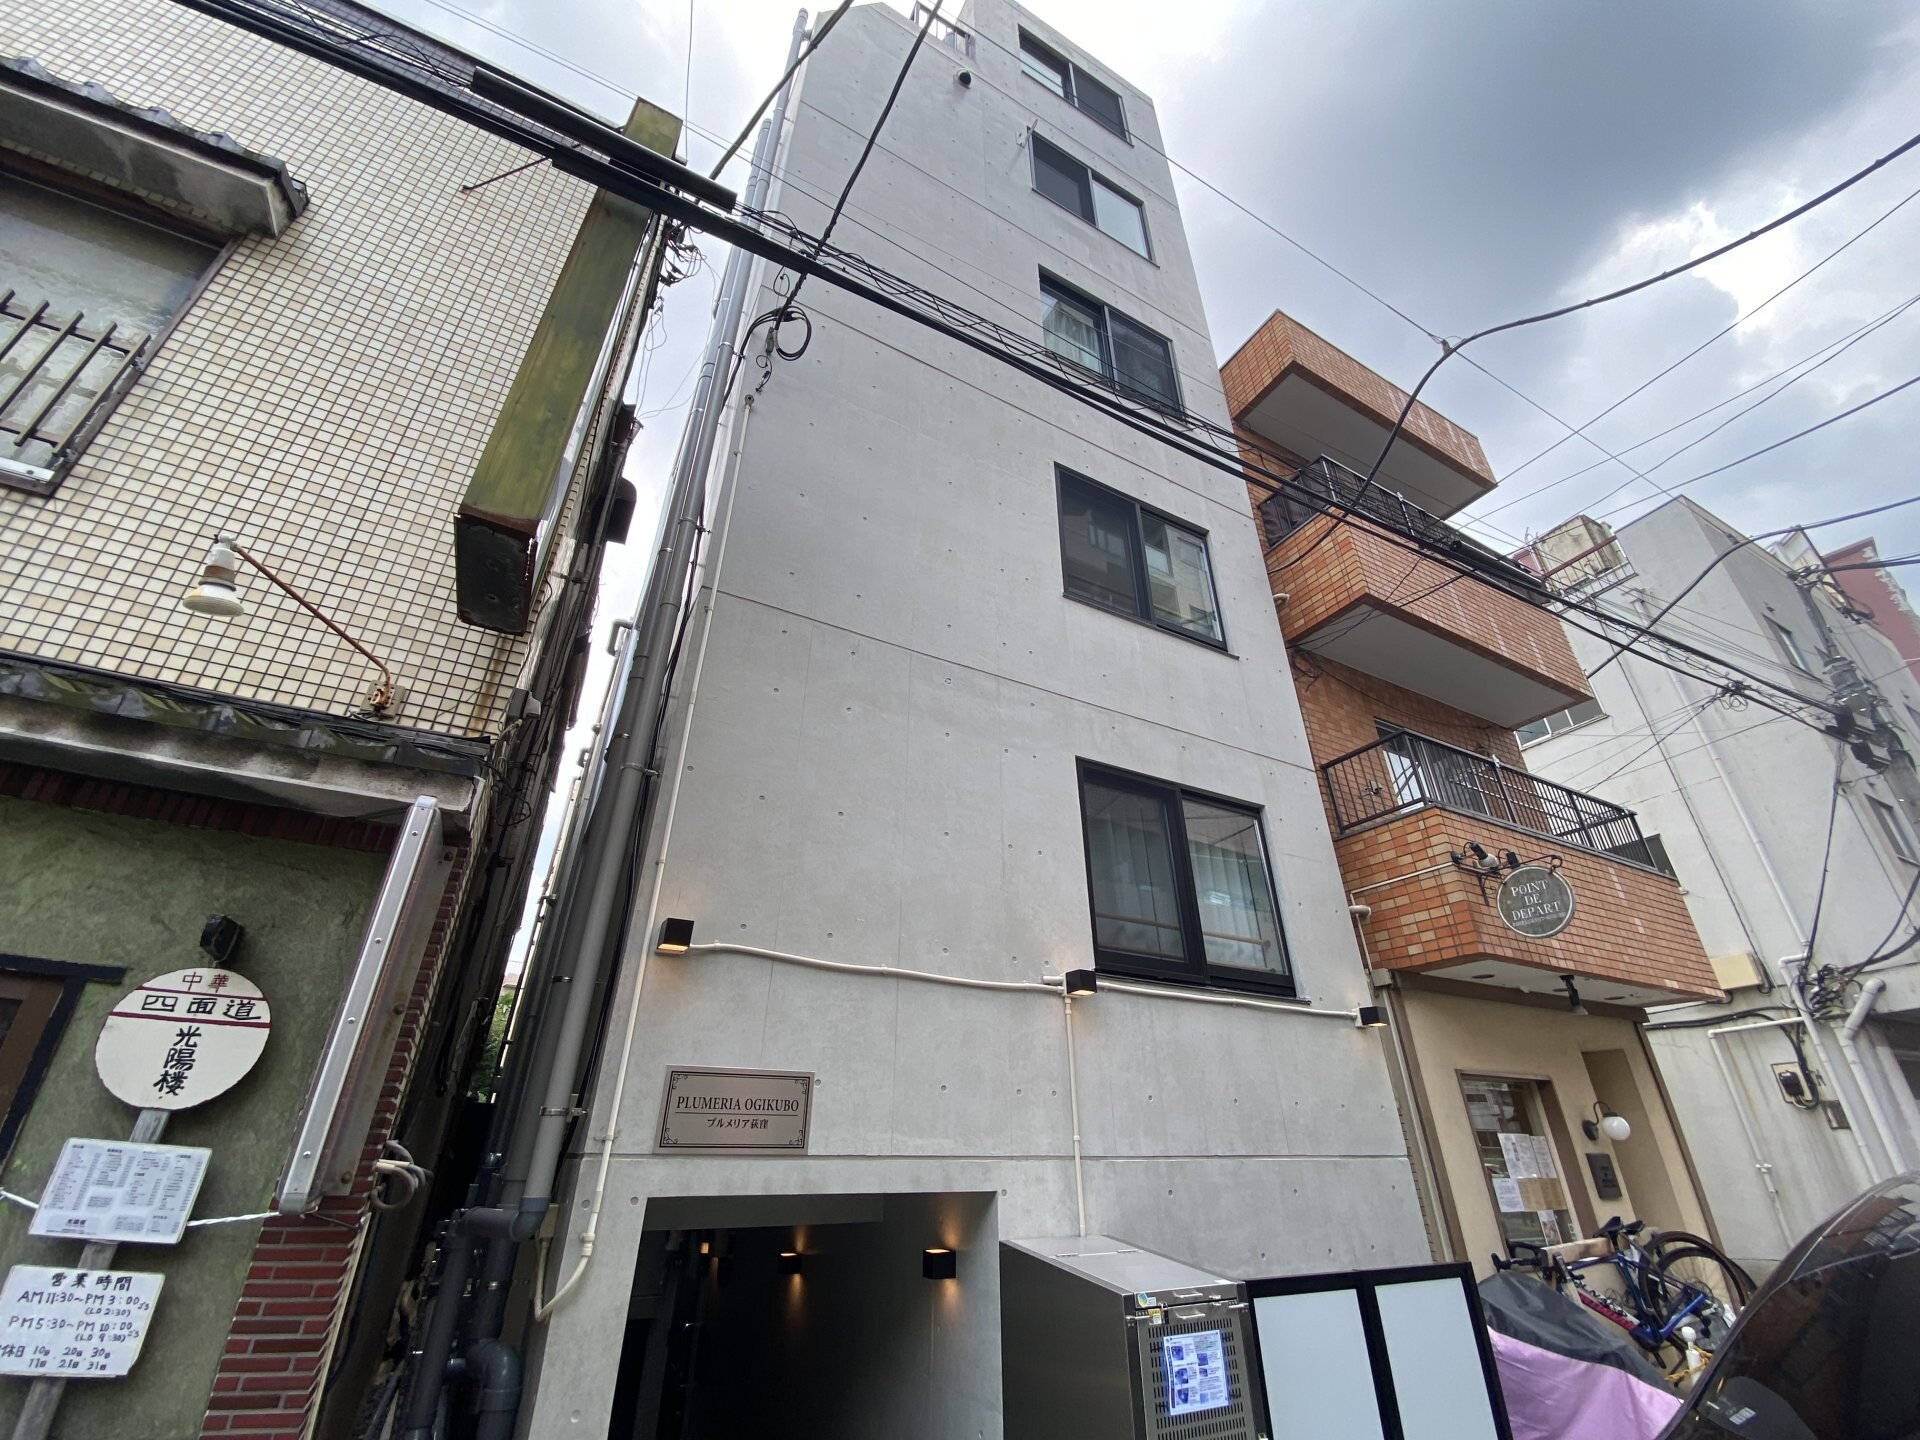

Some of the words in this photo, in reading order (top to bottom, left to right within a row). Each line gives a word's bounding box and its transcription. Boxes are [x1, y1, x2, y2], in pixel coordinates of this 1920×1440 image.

[1511, 879, 1548, 897] POINT
[1524, 893, 1542, 906] DE
[1511, 901, 1562, 921] DEPART
[182, 971, 230, 993] 中華
[141, 994, 262, 1021] 四面道
[153, 1025, 202, 1096] 光陽楼
[676, 1096, 741, 1110] PLUMERIA
[744, 1098, 799, 1111] OGIKUBO
[51, 1272, 133, 1291] 営業時間
[0, 1344, 26, 1358] 休日
